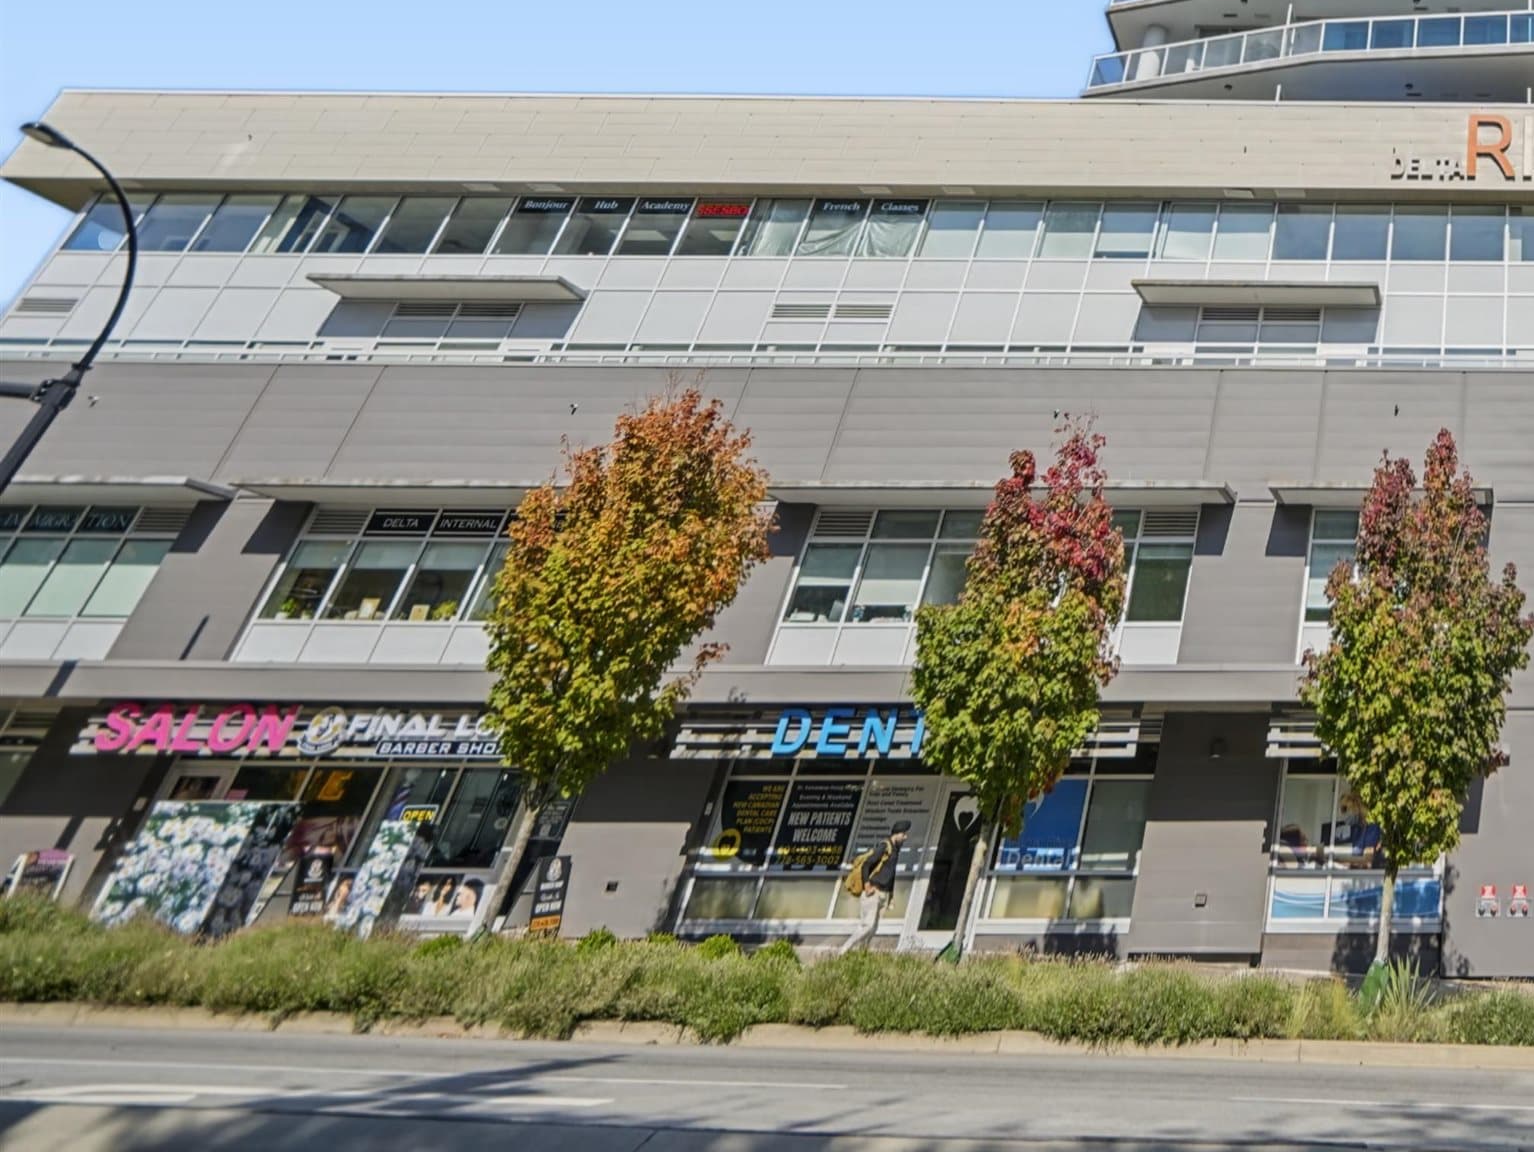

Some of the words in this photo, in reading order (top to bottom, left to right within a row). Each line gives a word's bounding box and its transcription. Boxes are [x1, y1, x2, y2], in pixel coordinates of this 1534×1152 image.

[525, 201, 568, 210] Bonjour
[594, 201, 618, 209] Hub
[642, 201, 690, 211] Academy
[823, 202, 860, 211] French
[881, 202, 919, 211] Classes
[383, 518, 420, 528] DELTA
[440, 519, 497, 529] INTERNAL
[95, 701, 303, 753] SALON
[347, 712, 449, 740] FINAL
[454, 713, 504, 740] LO
[380, 742, 450, 755] BARBER
[456, 741, 502, 755] SHO
[403, 808, 435, 822] OPEN
[787, 811, 810, 826] NEW
[810, 811, 852, 826] PATIENTS
[792, 827, 839, 842] WELCOME
[1007, 850, 1072, 867] Dental
